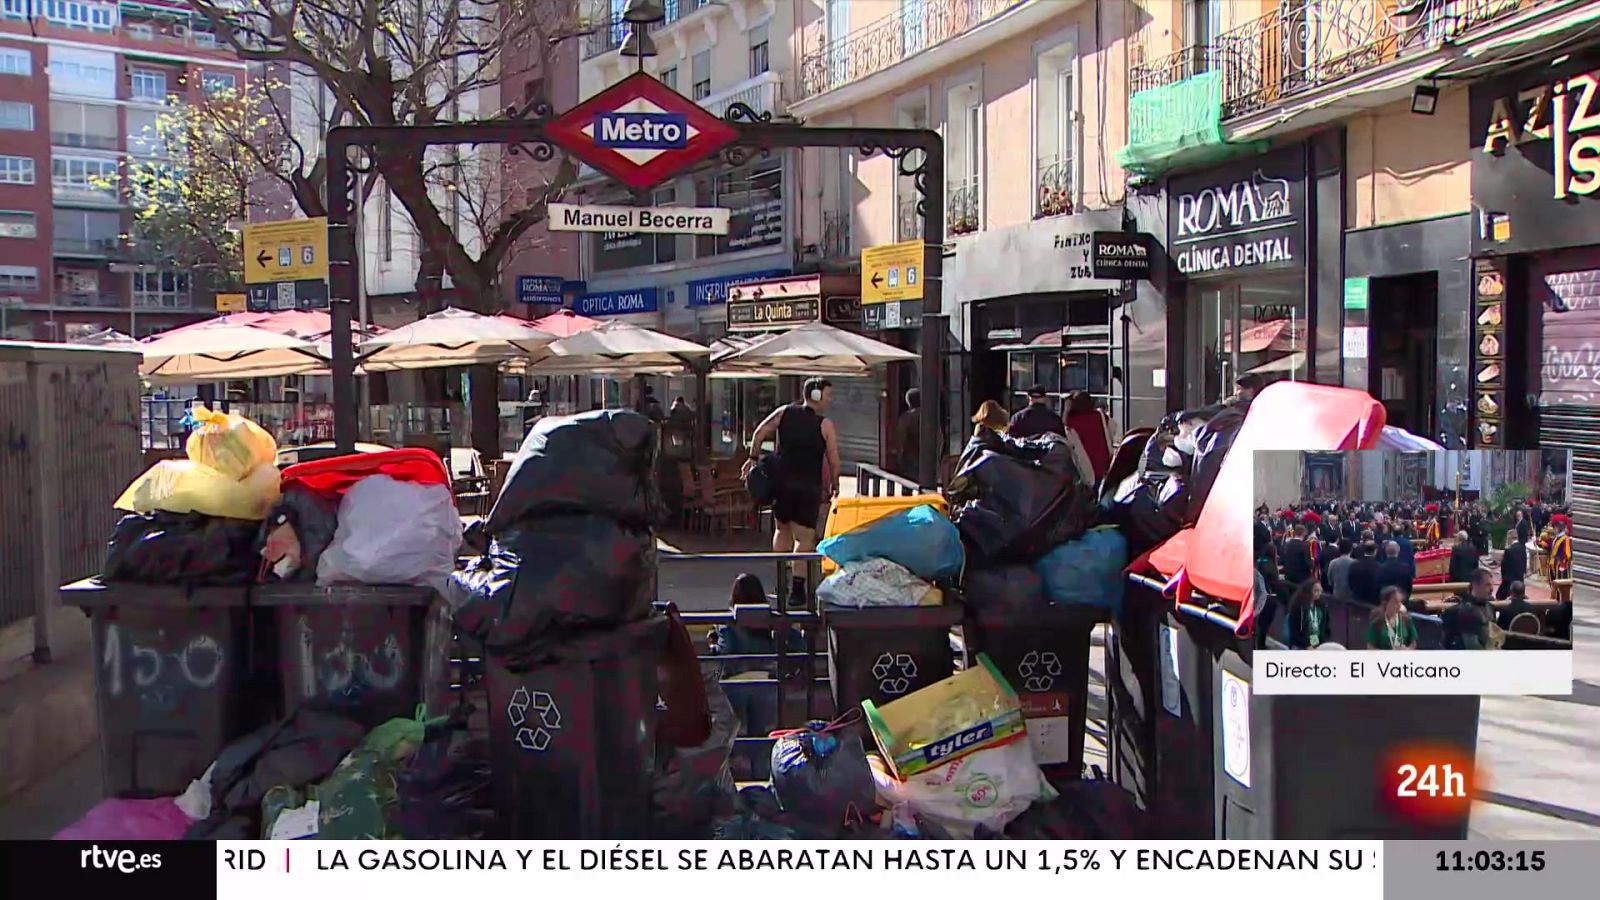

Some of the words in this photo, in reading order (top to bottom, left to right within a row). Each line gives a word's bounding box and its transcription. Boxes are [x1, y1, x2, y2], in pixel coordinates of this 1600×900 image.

[602, 118, 681, 142] Metro
[1178, 181, 1258, 236] ROMA
[564, 209, 632, 227] Manuel
[639, 211, 713, 229] Becerra
[303, 247, 313, 263] 6
[1083, 249, 1090, 262] Y
[1099, 245, 1134, 256] ROMA
[1177, 244, 1231, 274] CLÍNICA
[1234, 237, 1292, 267] DENTAL
[908, 268, 915, 285] 6
[618, 294, 645, 310] ROMA
[754, 305, 764, 320] La
[765, 302, 792, 323] Quinta
[930, 726, 988, 757] tyler
